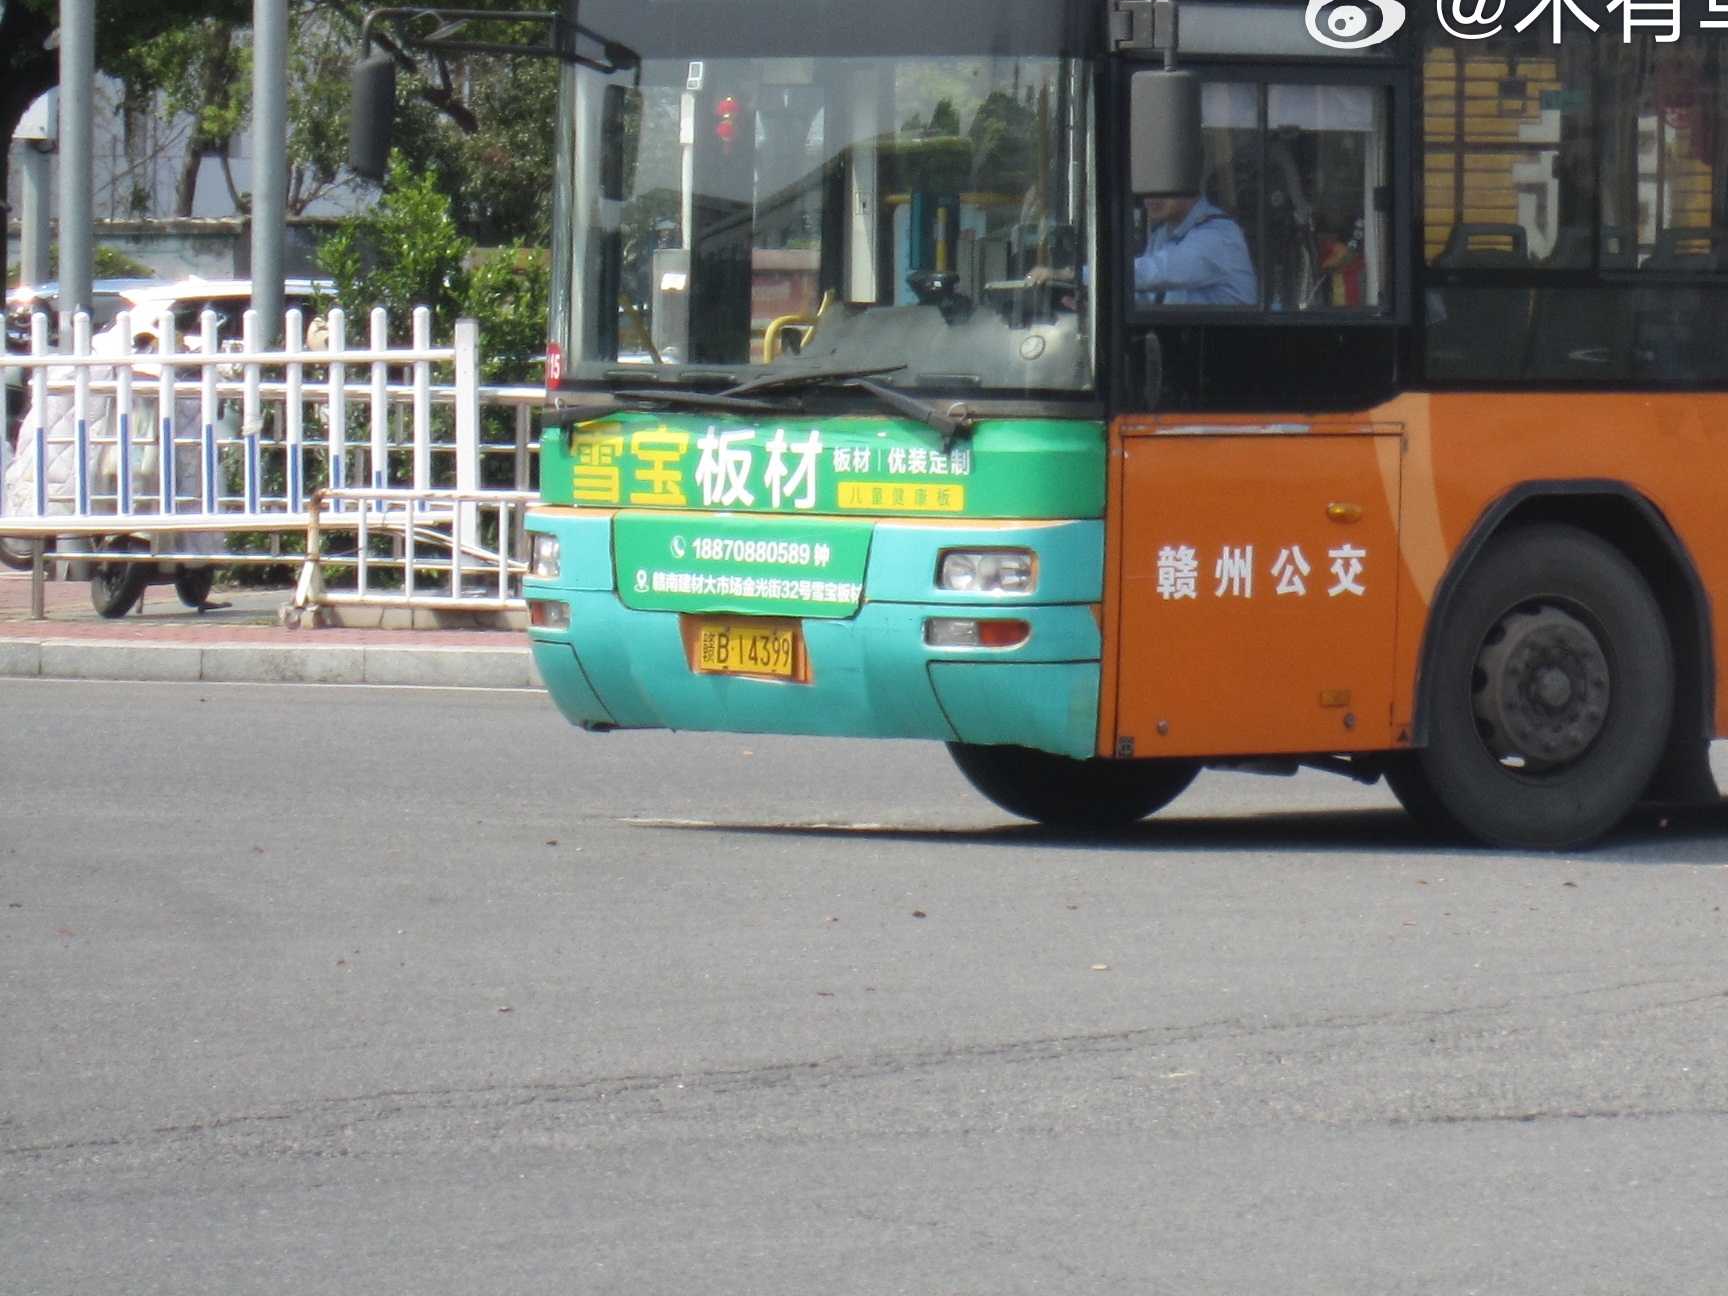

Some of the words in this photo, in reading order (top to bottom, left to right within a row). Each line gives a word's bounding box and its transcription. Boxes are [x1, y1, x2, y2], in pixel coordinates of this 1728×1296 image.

[570, 421, 823, 510] 雪宝板材
[848, 485, 952, 509] 儿童健康板
[691, 538, 811, 567] 18870880589
[813, 544, 831, 568] 钟
[1156, 543, 1367, 600] 赣州公交
